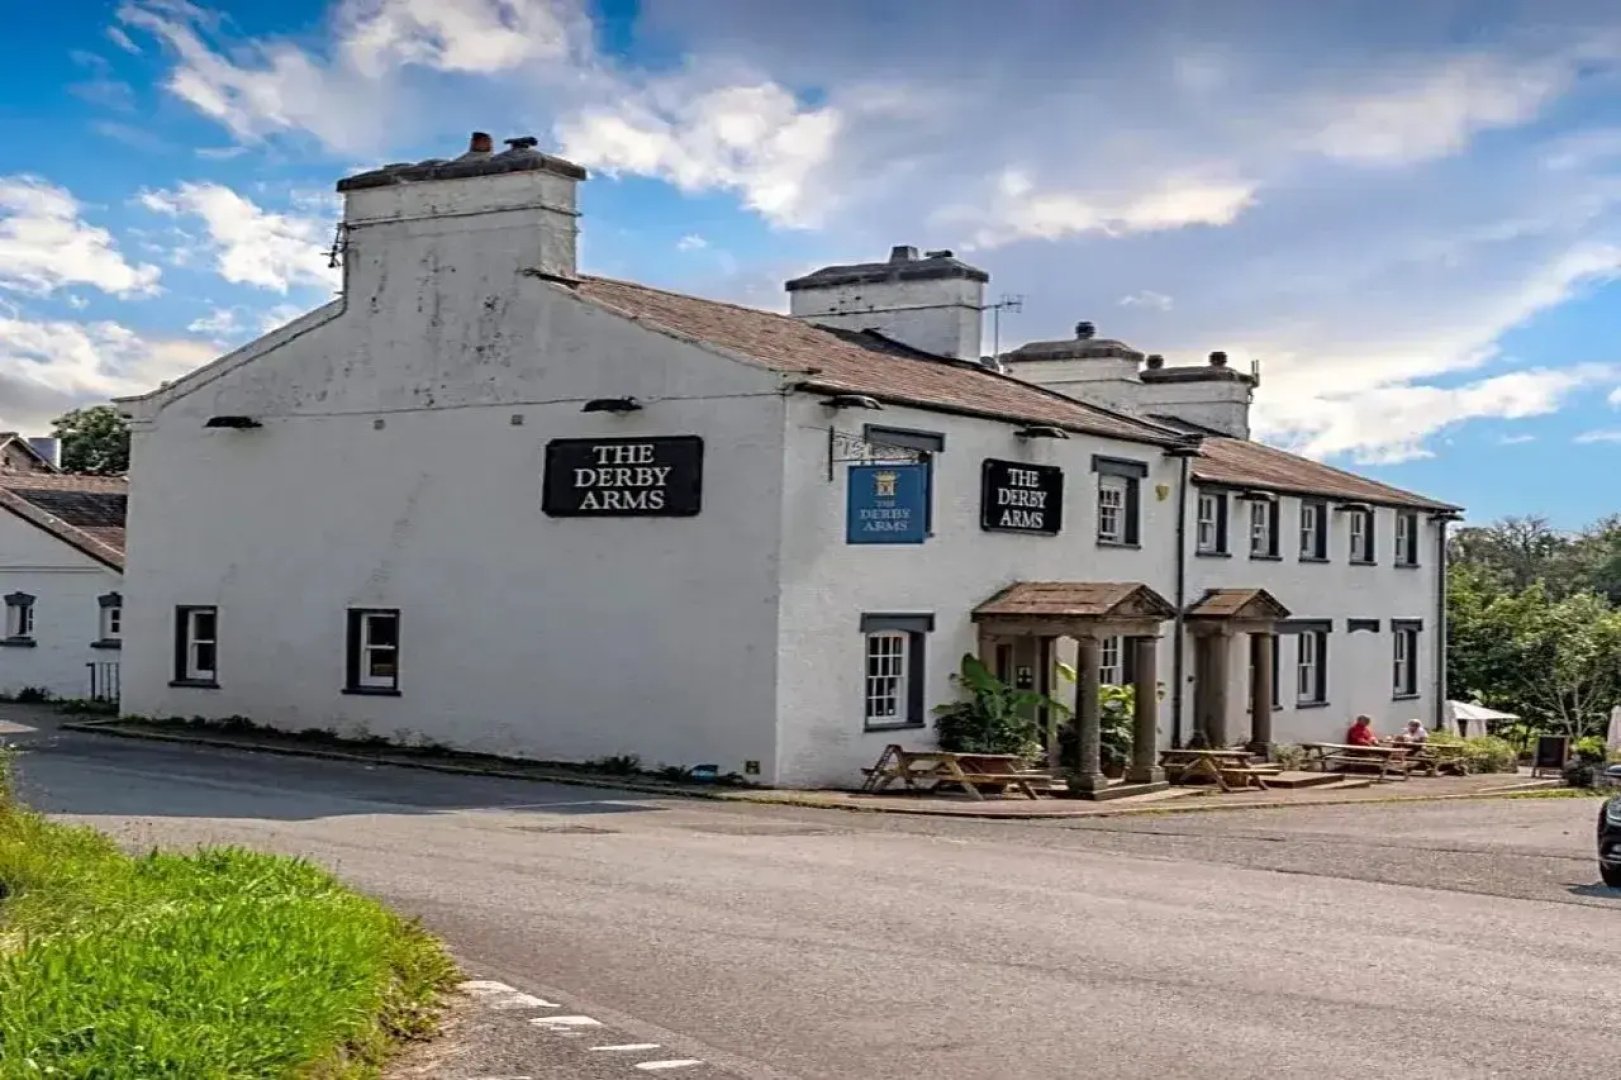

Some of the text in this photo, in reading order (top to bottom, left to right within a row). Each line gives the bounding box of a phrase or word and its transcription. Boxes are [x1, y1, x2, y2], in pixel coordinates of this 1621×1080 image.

[592, 444, 655, 464] THE
[573, 466, 672, 487] DERBY
[1007, 468, 1039, 488] THE
[579, 490, 665, 510] ARMS
[998, 487, 1047, 509] DERBY
[860, 508, 911, 519] DERBY
[999, 508, 1044, 529] ARMS
[862, 520, 908, 532] ARMS
